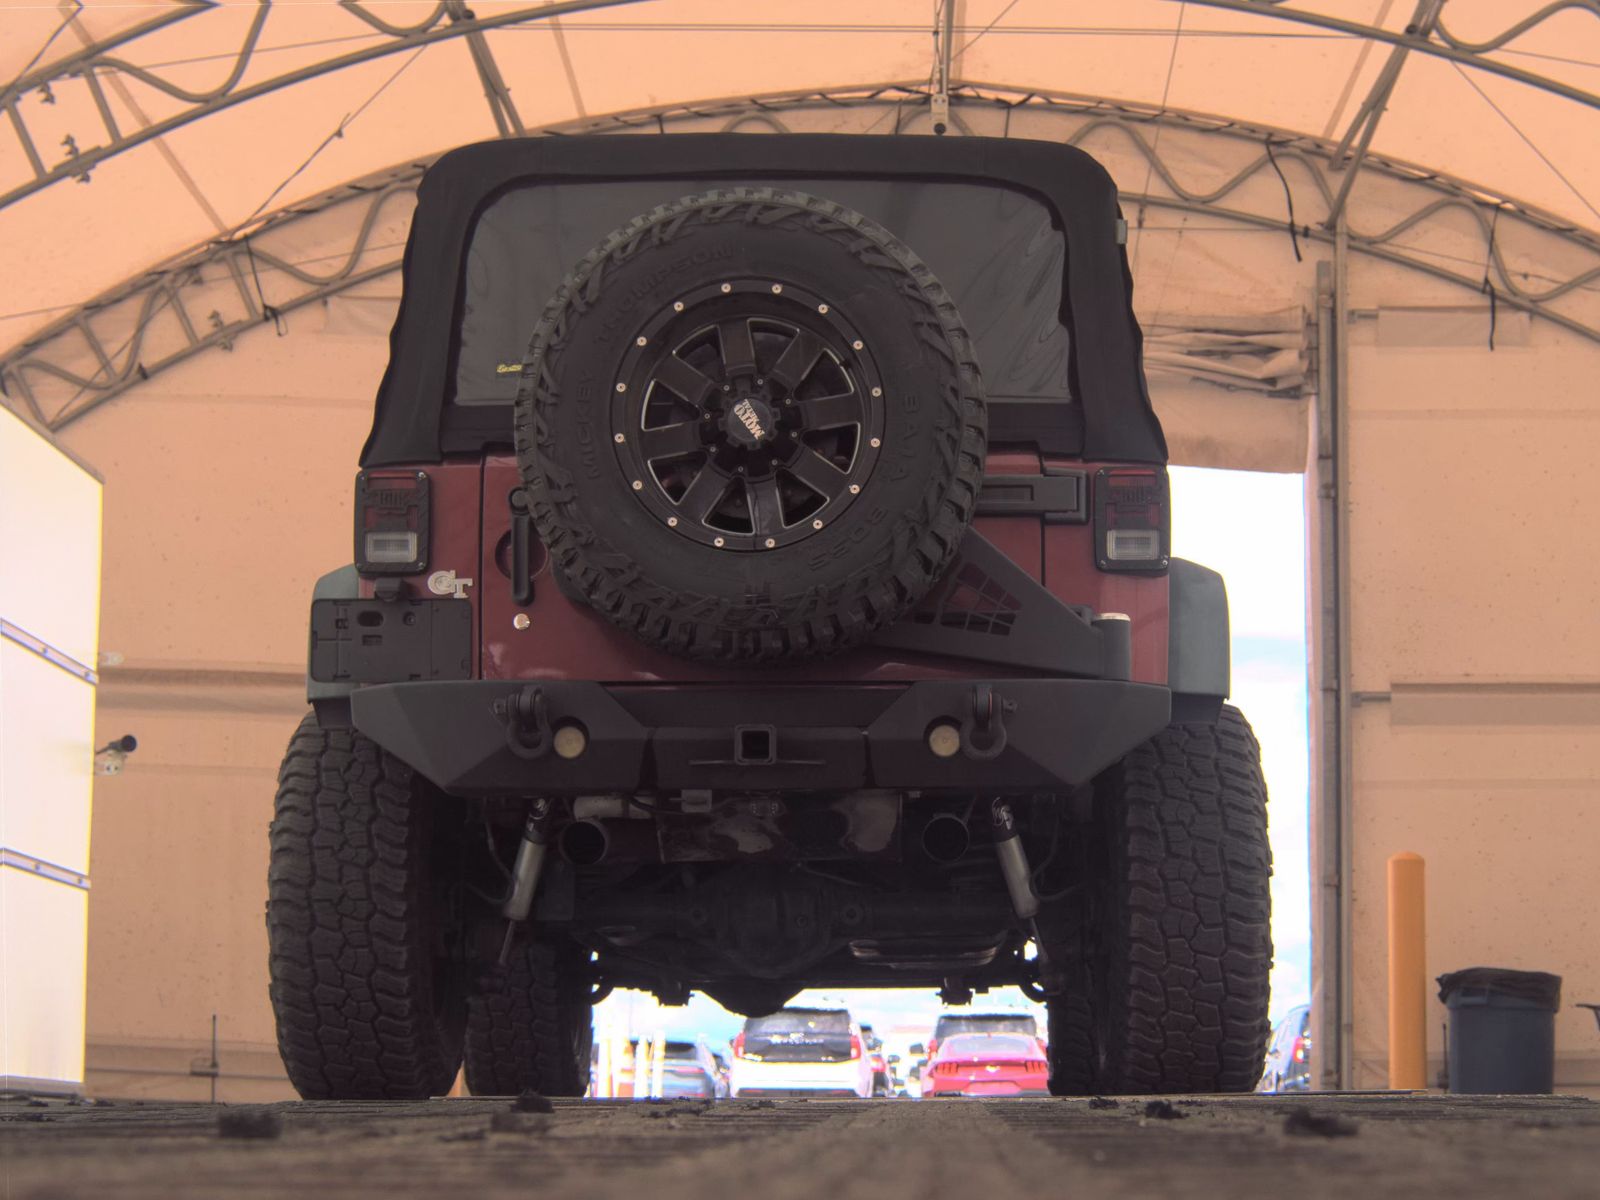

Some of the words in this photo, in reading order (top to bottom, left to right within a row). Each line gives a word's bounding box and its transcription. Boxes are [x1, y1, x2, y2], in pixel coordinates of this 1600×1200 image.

[577, 369, 601, 480] MICKEY
[593, 246, 734, 345] THOMPSON
[734, 403, 766, 440] MOTO
[742, 398, 760, 423] METAL
[888, 394, 921, 482] BAJA
[809, 507, 888, 571] BOSS
[427, 569, 473, 599] GT
